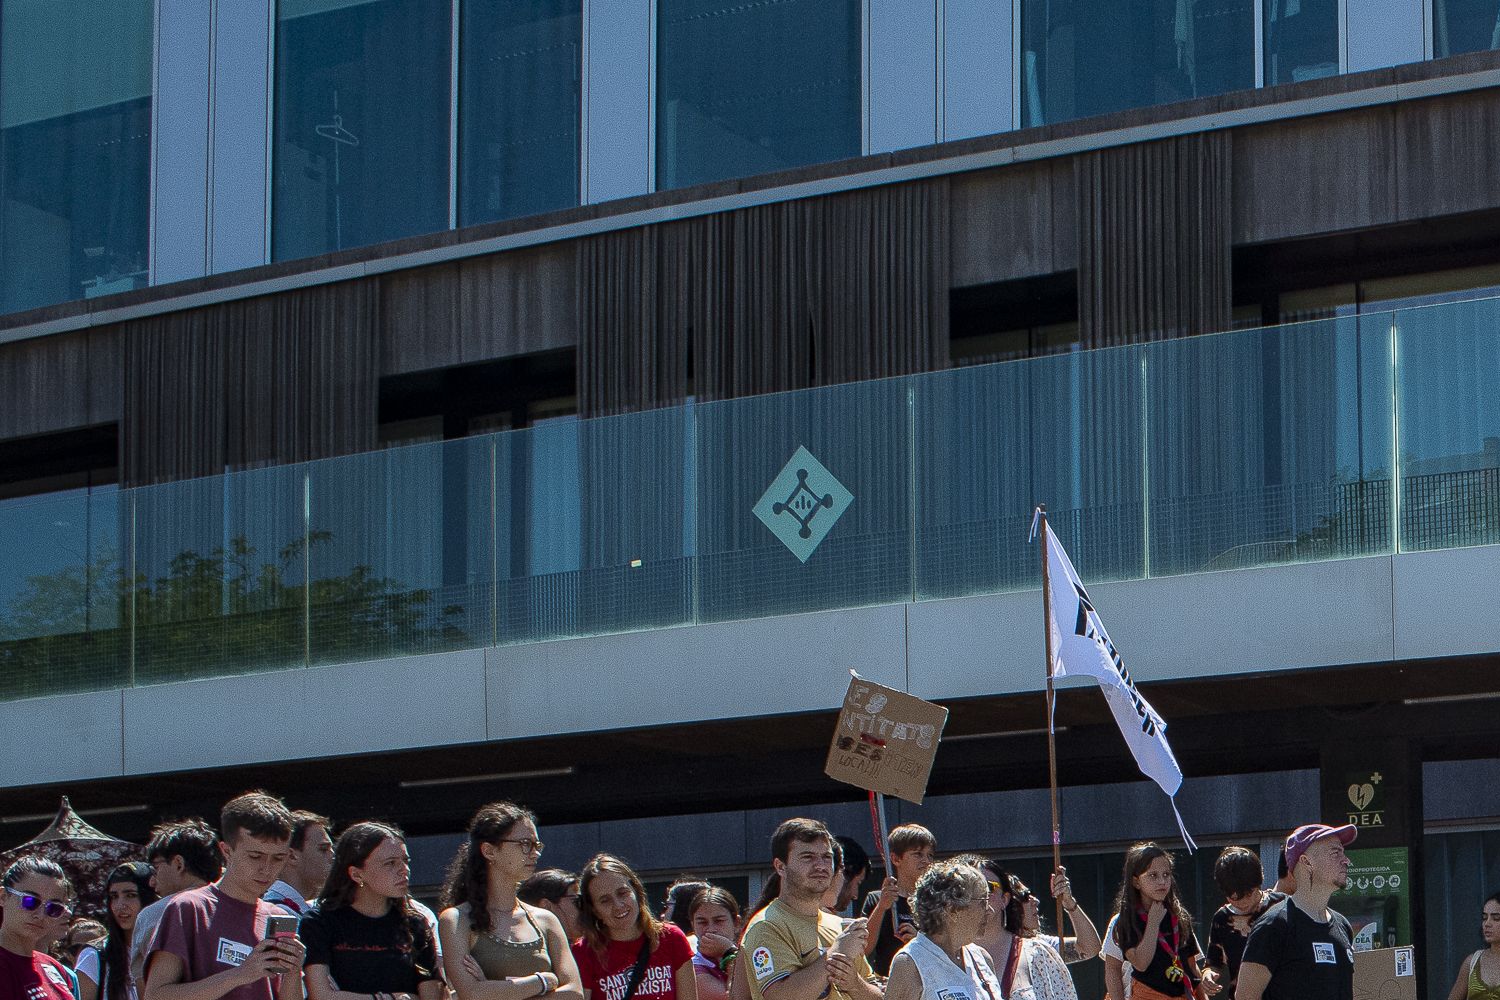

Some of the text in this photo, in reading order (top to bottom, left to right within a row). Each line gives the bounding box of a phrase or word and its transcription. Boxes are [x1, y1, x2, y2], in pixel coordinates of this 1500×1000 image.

[1350, 814, 1383, 826] DEA
[599, 965, 672, 993] SANT UGAT
